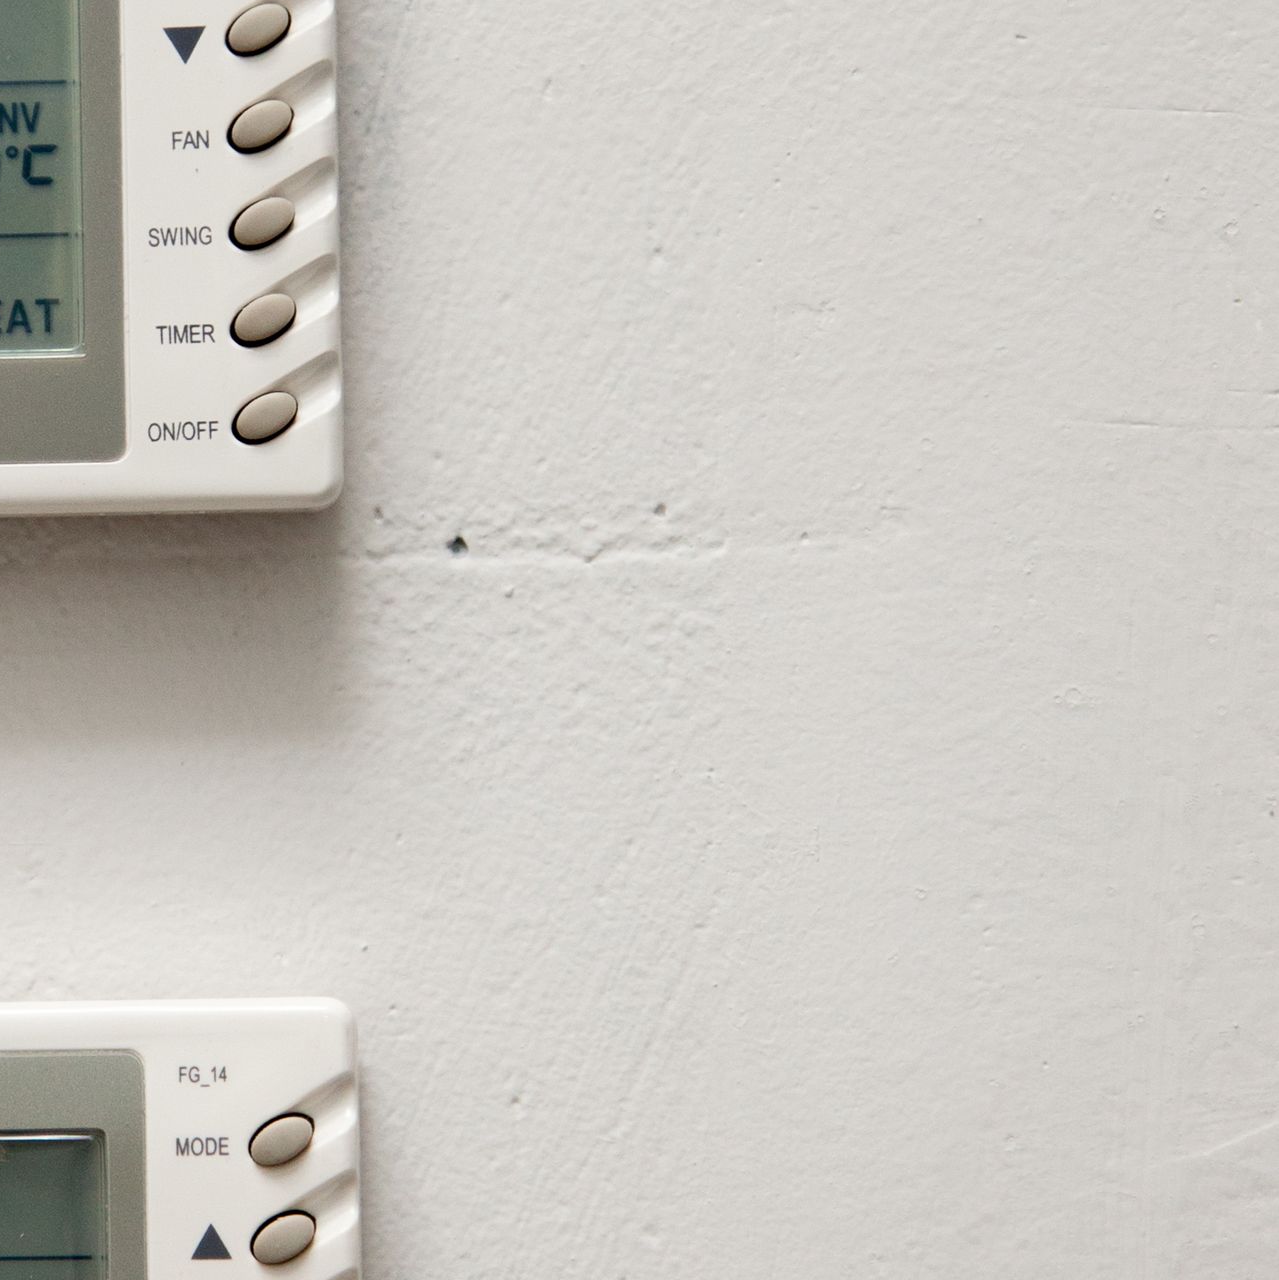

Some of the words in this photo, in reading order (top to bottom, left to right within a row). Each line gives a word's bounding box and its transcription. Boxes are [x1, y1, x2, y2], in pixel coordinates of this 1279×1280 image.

[171, 130, 210, 150] FAN
[148, 226, 212, 248] SWING
[155, 324, 215, 345] TIMER
[147, 420, 219, 443] ON/OFF
[178, 1065, 228, 1088] FG_14
[175, 1137, 229, 1157] MODE
